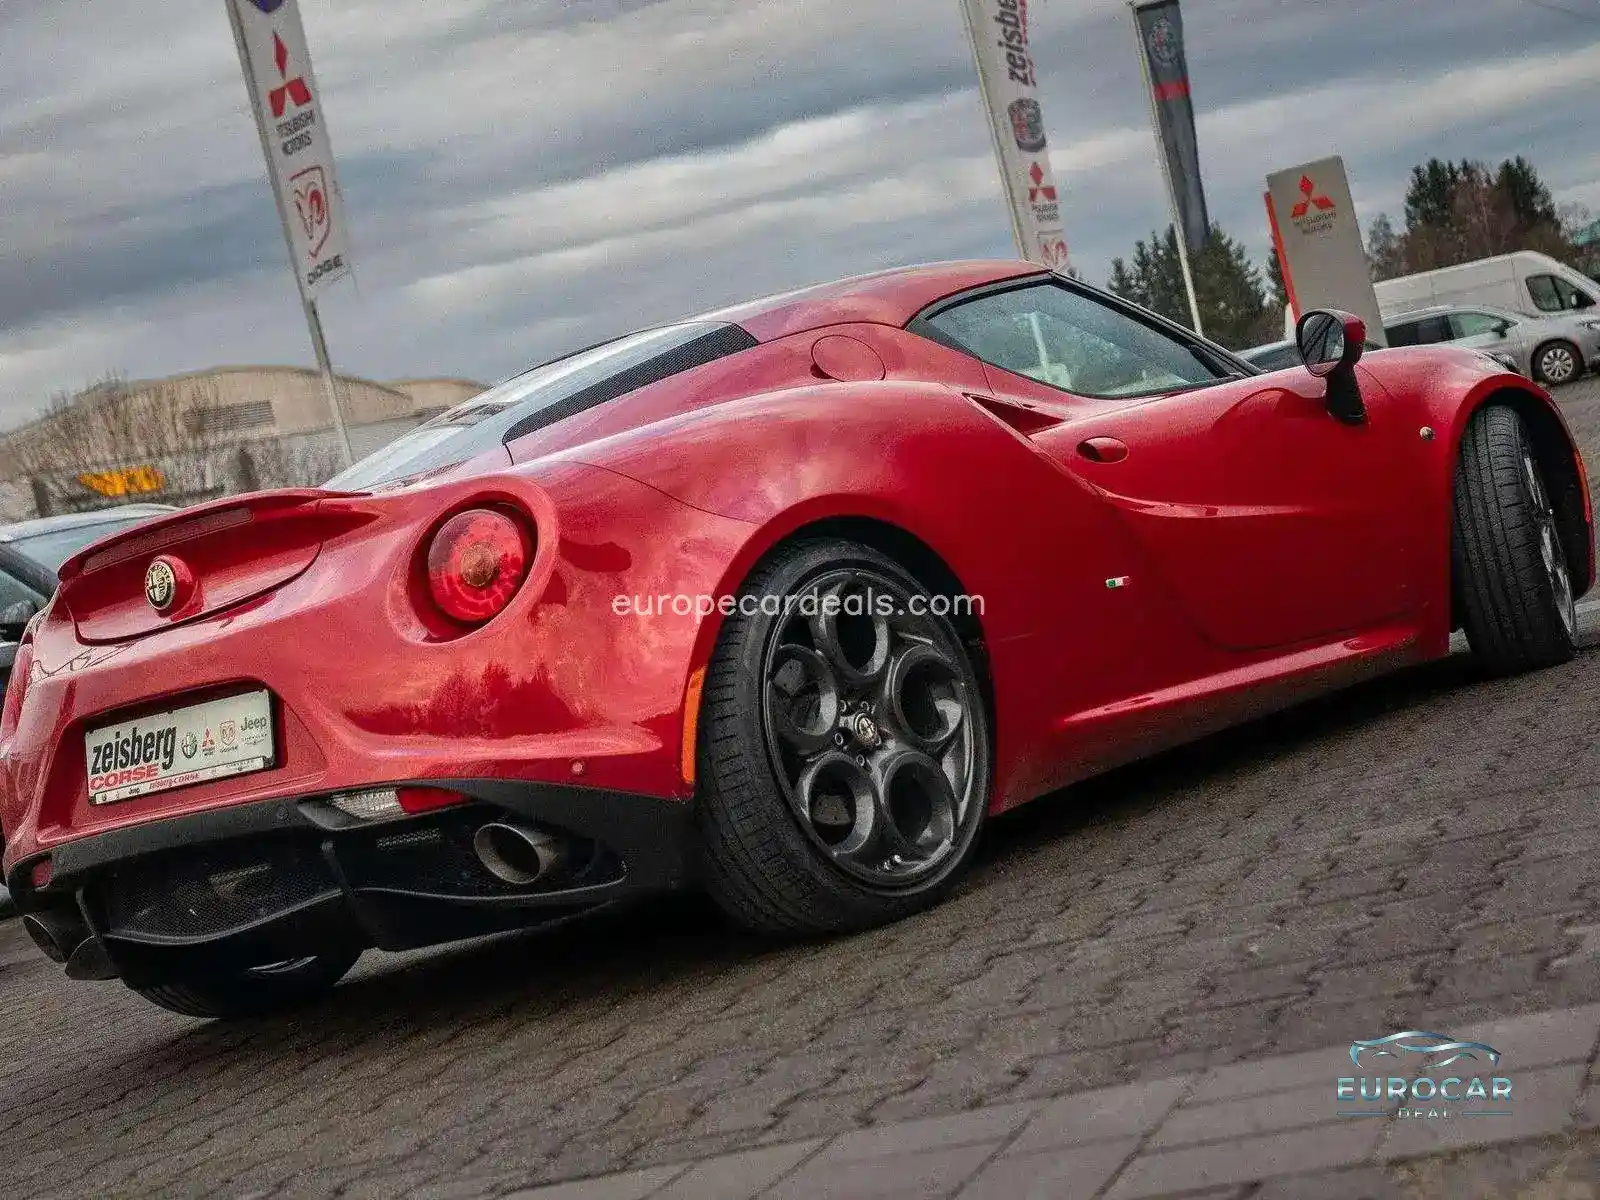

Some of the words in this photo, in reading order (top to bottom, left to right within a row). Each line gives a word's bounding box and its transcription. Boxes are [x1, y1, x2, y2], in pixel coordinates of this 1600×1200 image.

[241, 717, 267, 731] Jeep
[91, 726, 177, 775] zeisberg
[89, 763, 159, 791] CORSE
